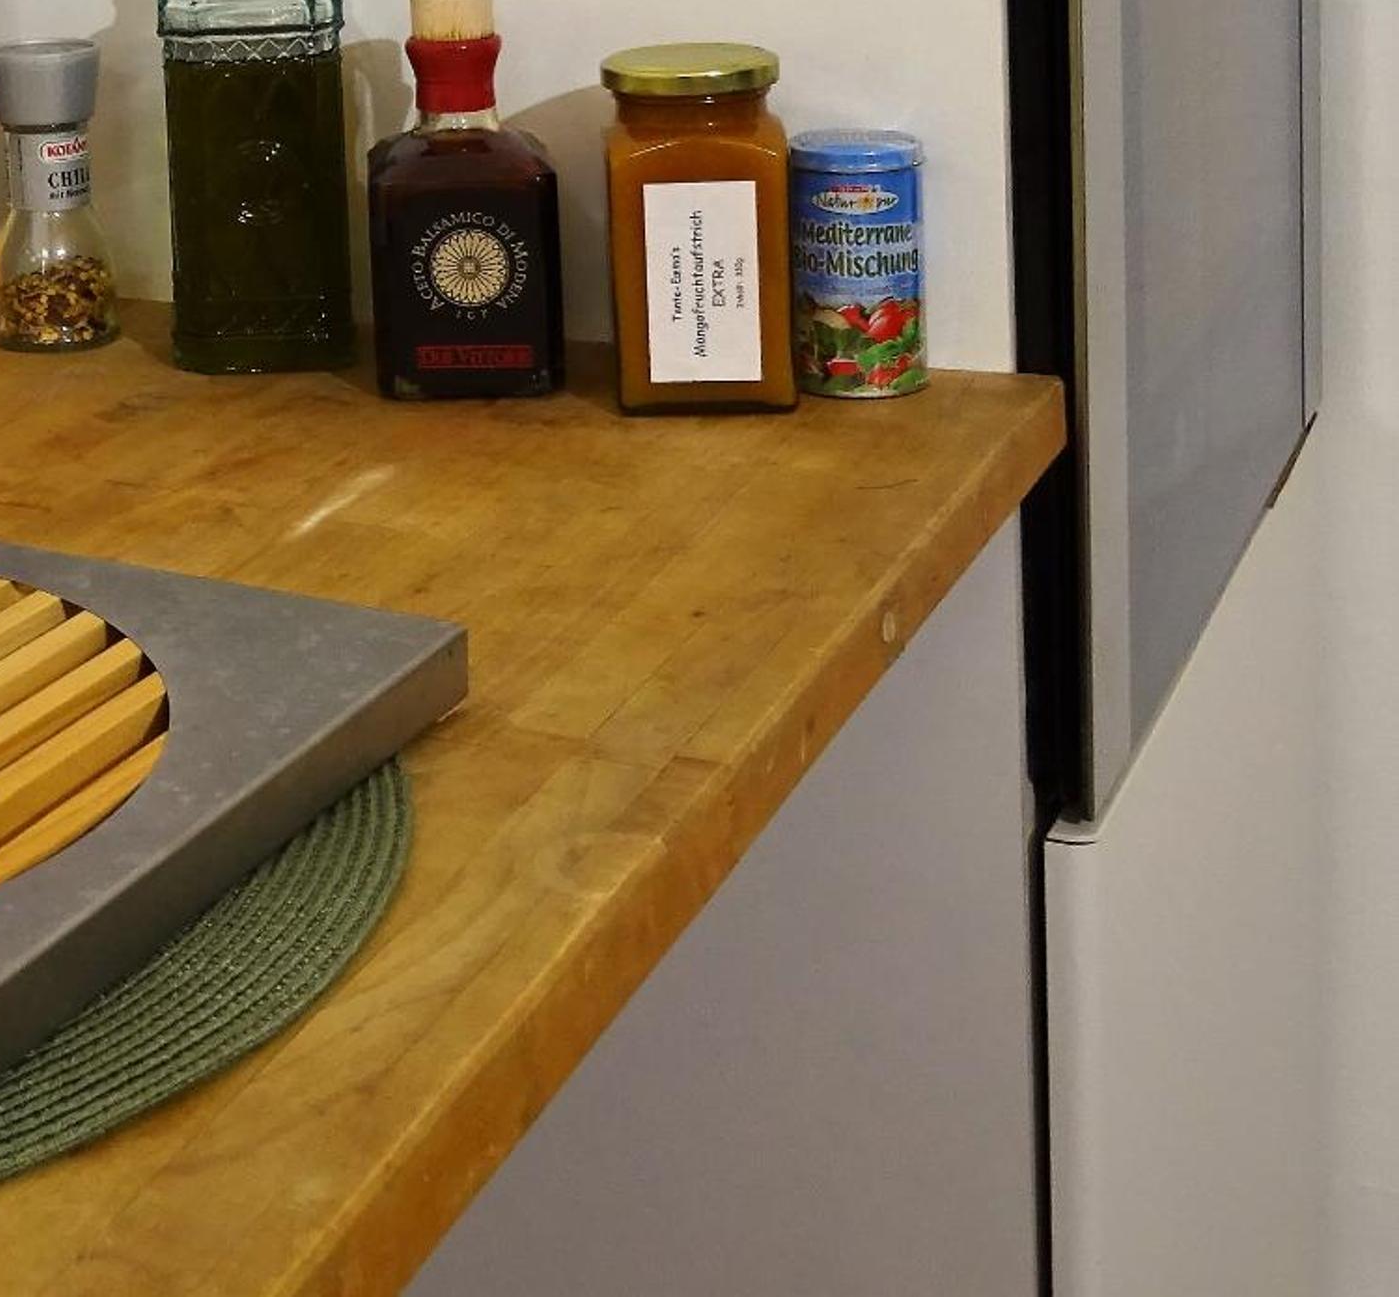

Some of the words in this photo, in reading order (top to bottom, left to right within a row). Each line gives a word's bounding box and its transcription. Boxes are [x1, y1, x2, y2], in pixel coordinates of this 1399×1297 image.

[411, 211, 496, 258] BALSAMICO
[802, 221, 913, 246] Mediterrane
[496, 240, 530, 310] MODENA
[688, 209, 710, 358] Mangofruchtaufstrich
[711, 258, 726, 308] EXTRA
[794, 245, 919, 278] Bio-Mischung
[411, 262, 446, 311] ACETO
